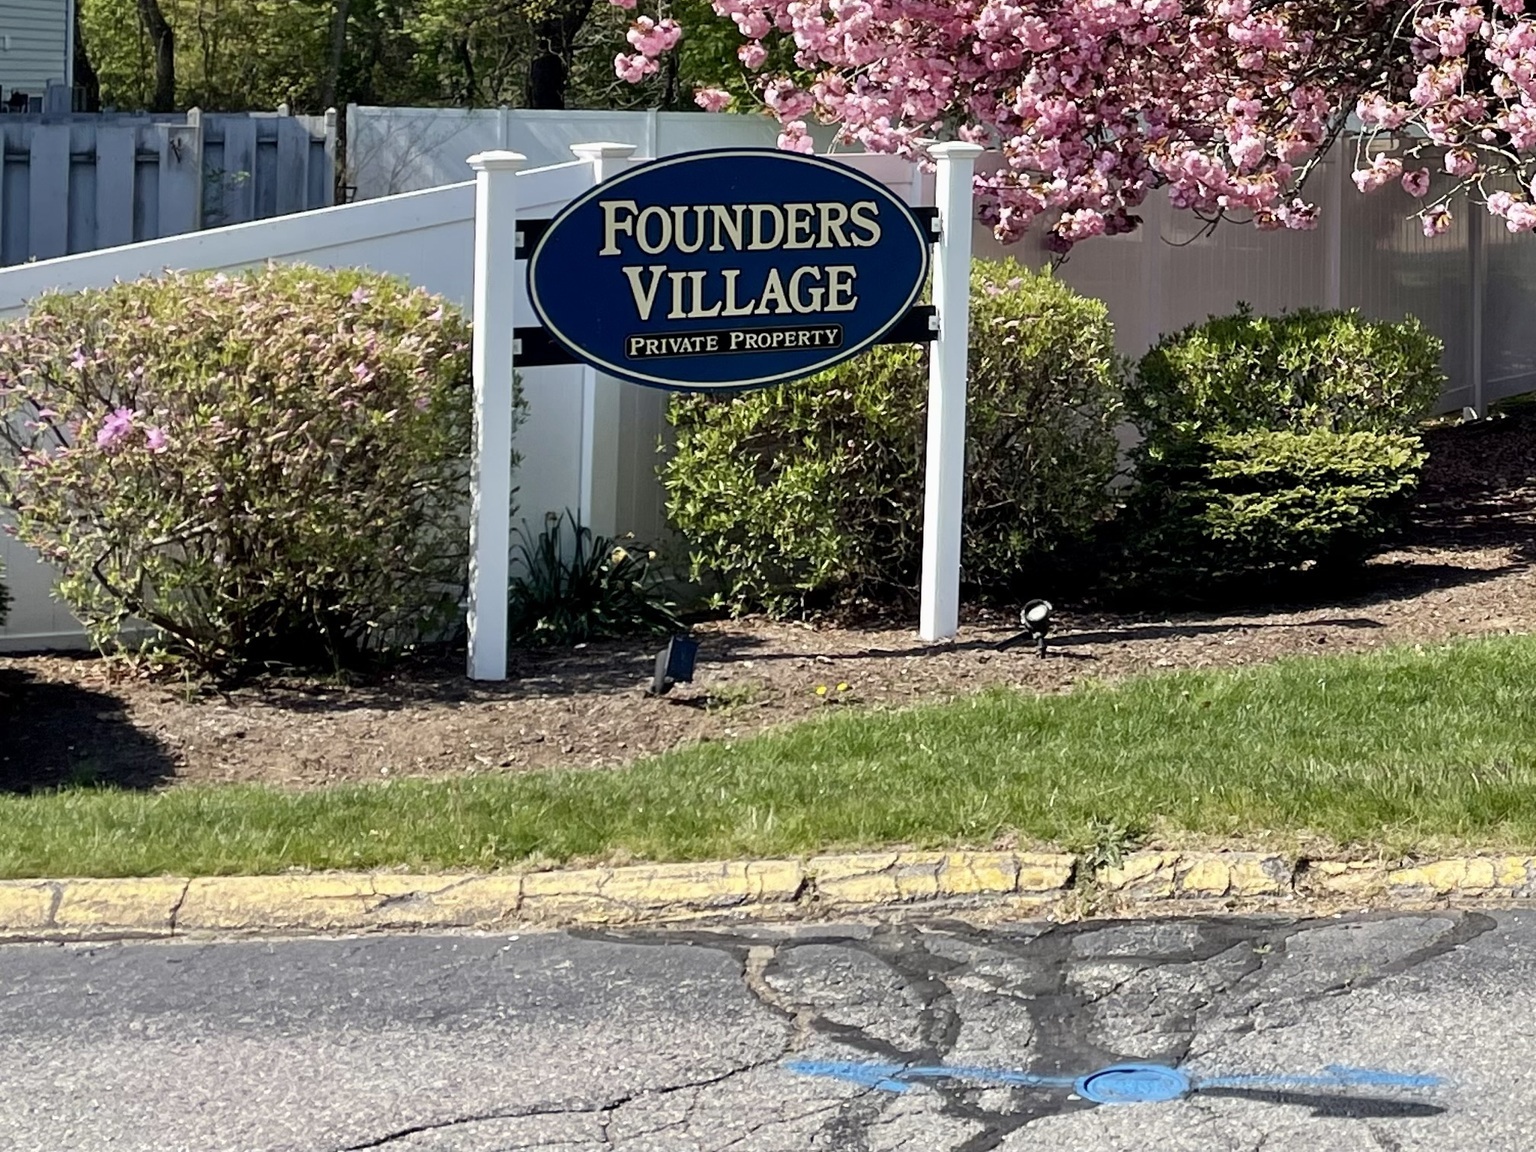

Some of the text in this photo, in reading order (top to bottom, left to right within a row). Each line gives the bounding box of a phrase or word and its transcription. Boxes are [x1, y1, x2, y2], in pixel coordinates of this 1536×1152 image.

[598, 200, 882, 256] FOUNDERS
[622, 265, 859, 321] VILLAGE
[630, 328, 839, 356] PRIVATE PROPERTY
